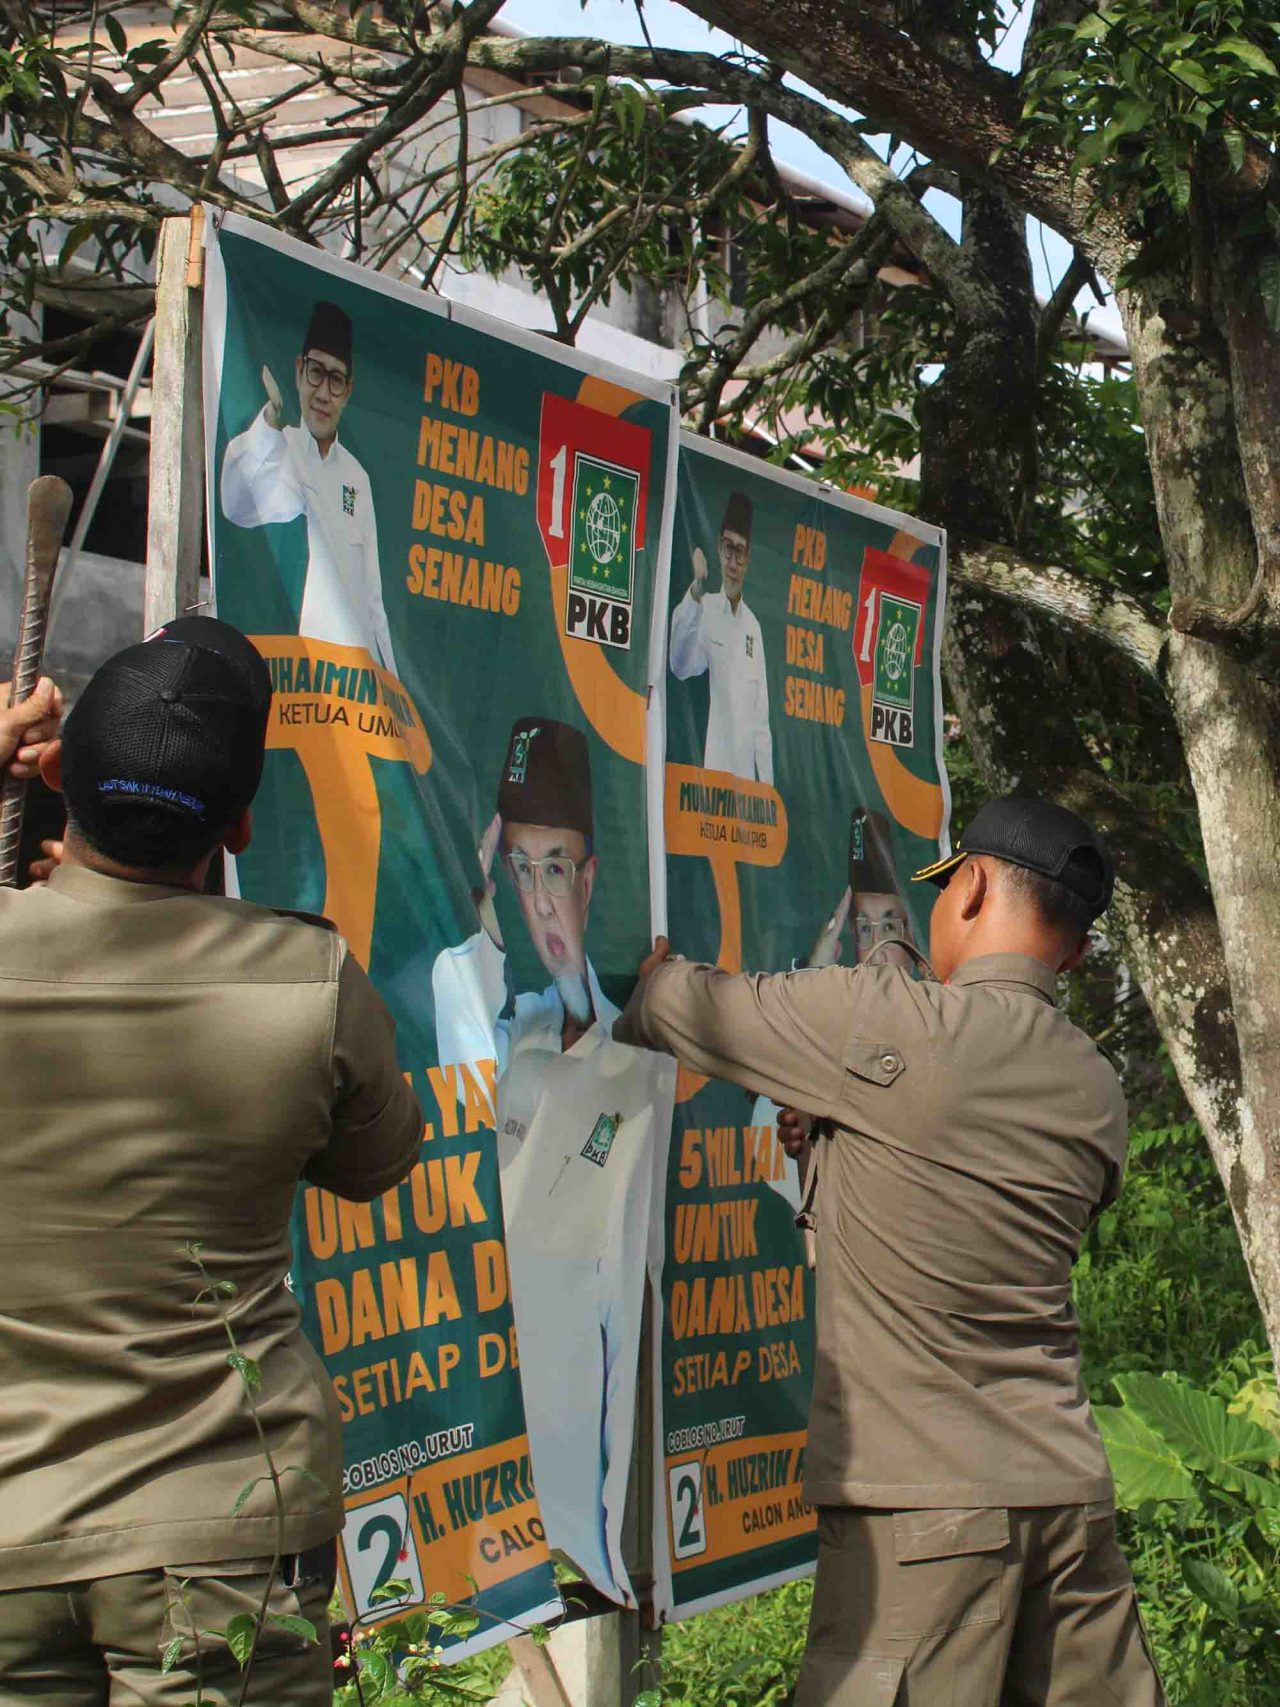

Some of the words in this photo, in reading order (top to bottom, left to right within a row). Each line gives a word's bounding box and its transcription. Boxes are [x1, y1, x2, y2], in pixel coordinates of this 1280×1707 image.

[424, 352, 479, 417] PKB
[417, 415, 529, 496] MENANG
[411, 478, 485, 547] DESA
[549, 444, 567, 539] 1
[792, 523, 826, 572] PKB
[406, 543, 521, 617] SENANG
[787, 573, 852, 631] MENANG
[568, 593, 631, 645] PKB
[785, 624, 824, 674] DESA
[860, 587, 876, 662] 1
[265, 657, 377, 705] UHAIMIN
[784, 675, 846, 727] SENANG
[279, 703, 349, 727] KETUA
[871, 704, 912, 745] PKB
[678, 1129, 702, 1189] 5
[674, 1198, 759, 1265] UNTUK
[315, 1250, 462, 1356] DANA
[671, 1274, 751, 1341] DANA
[751, 1265, 805, 1329] DESA
[332, 1343, 461, 1423] SETIAP
[672, 1351, 752, 1398] SETIAP
[758, 1340, 801, 1383] DESA
[399, 1440, 427, 1474] NO.
[425, 1423, 474, 1459] URUT
[677, 1475, 700, 1549] 2
[706, 1464, 724, 1507] H.
[727, 1448, 793, 1501] HUZRIN
[742, 1503, 783, 1534] CALON
[358, 1514, 411, 1608] 2
[413, 1491, 446, 1545] H.
